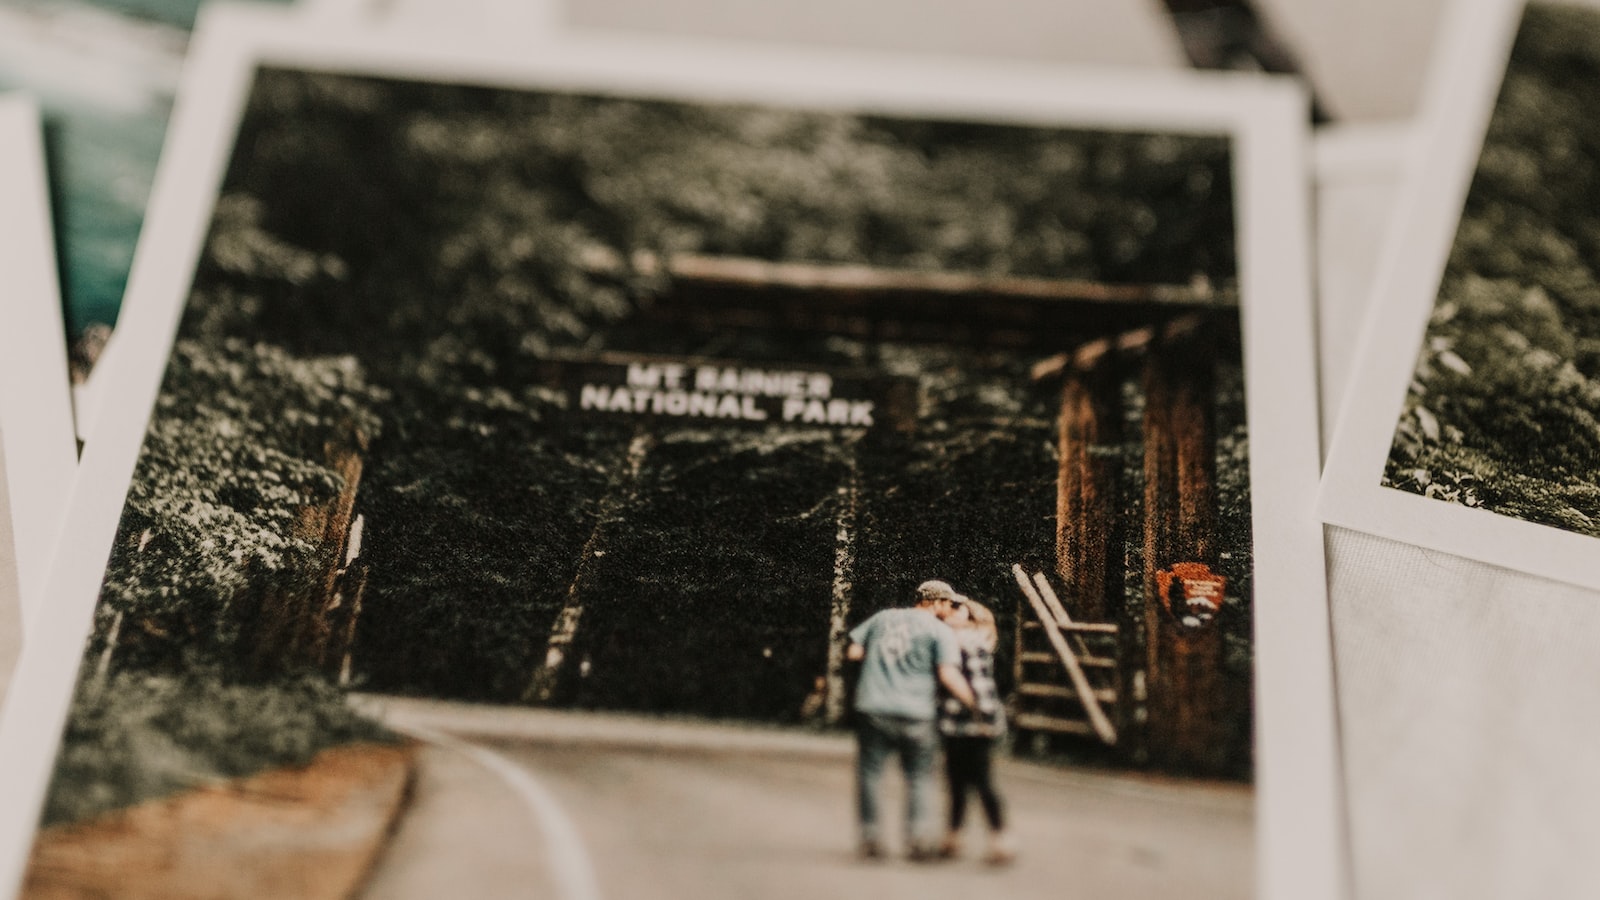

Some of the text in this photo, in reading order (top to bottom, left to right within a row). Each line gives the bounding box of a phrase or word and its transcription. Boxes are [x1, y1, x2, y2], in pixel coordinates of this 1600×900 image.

[696, 366, 833, 398] RAINIER
[580, 384, 875, 426] NATIONAL PARK
